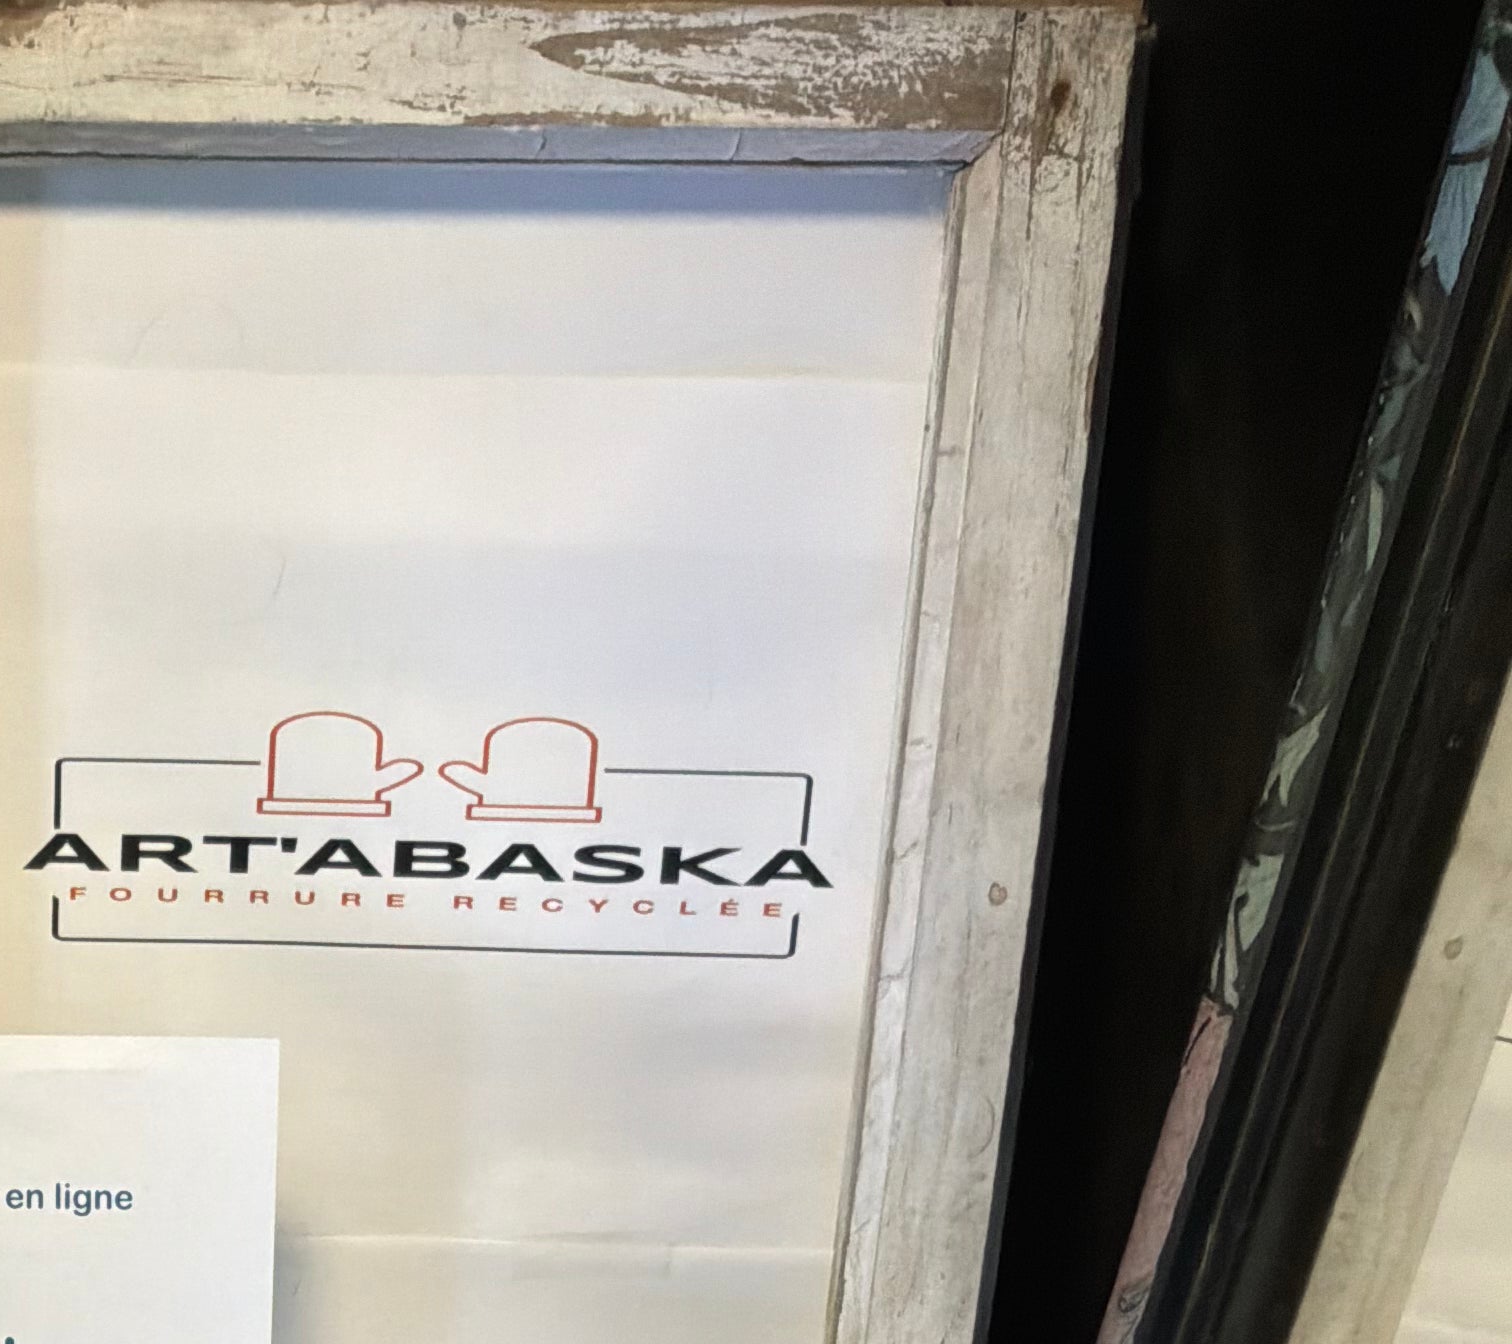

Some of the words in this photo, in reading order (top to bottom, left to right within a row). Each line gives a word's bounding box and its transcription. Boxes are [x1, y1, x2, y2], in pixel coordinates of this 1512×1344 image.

[22, 832, 834, 890] ART'ABASKA
[68, 885, 406, 911] FOURRURE
[453, 896, 784, 919] RECYCLÉE
[5, 1188, 45, 1211] en
[55, 1182, 134, 1217] ligne
